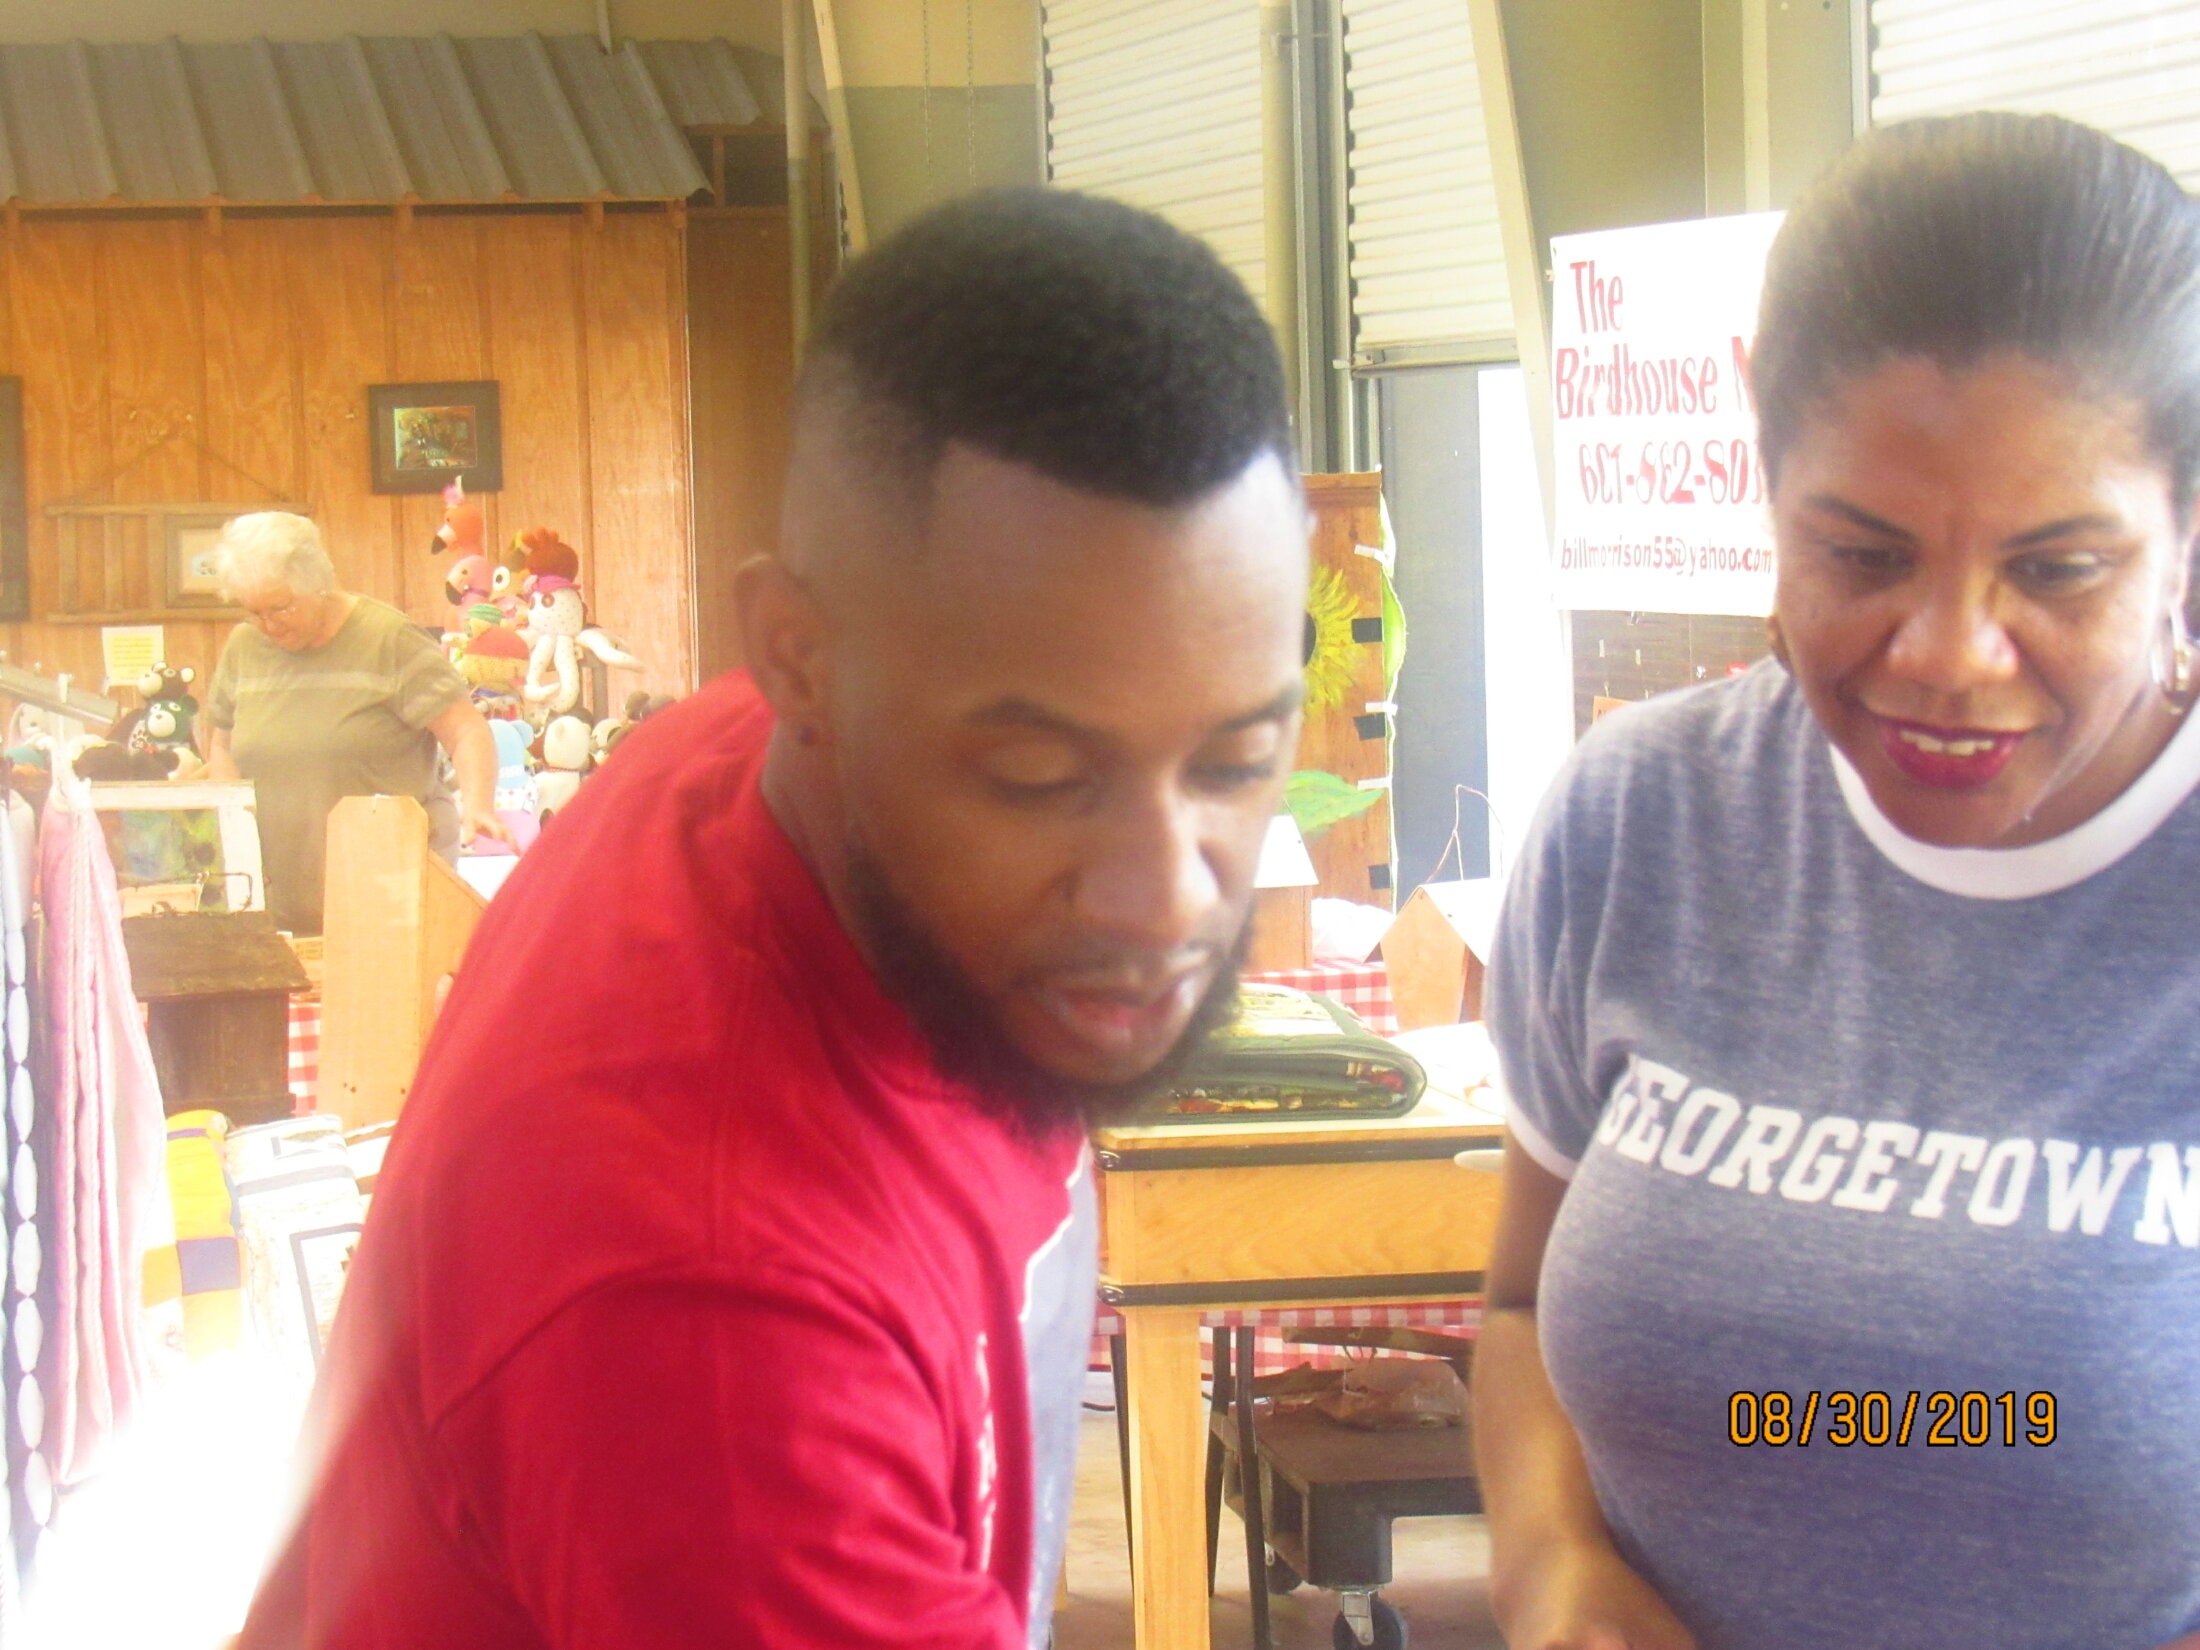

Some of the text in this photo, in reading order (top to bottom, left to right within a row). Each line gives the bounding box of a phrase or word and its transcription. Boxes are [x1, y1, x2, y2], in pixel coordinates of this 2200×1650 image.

[1570, 260, 1624, 334] The
[1556, 343, 1718, 419] Birdhouse
[1560, 535, 1773, 577] billmorrison55@yahoo.com
